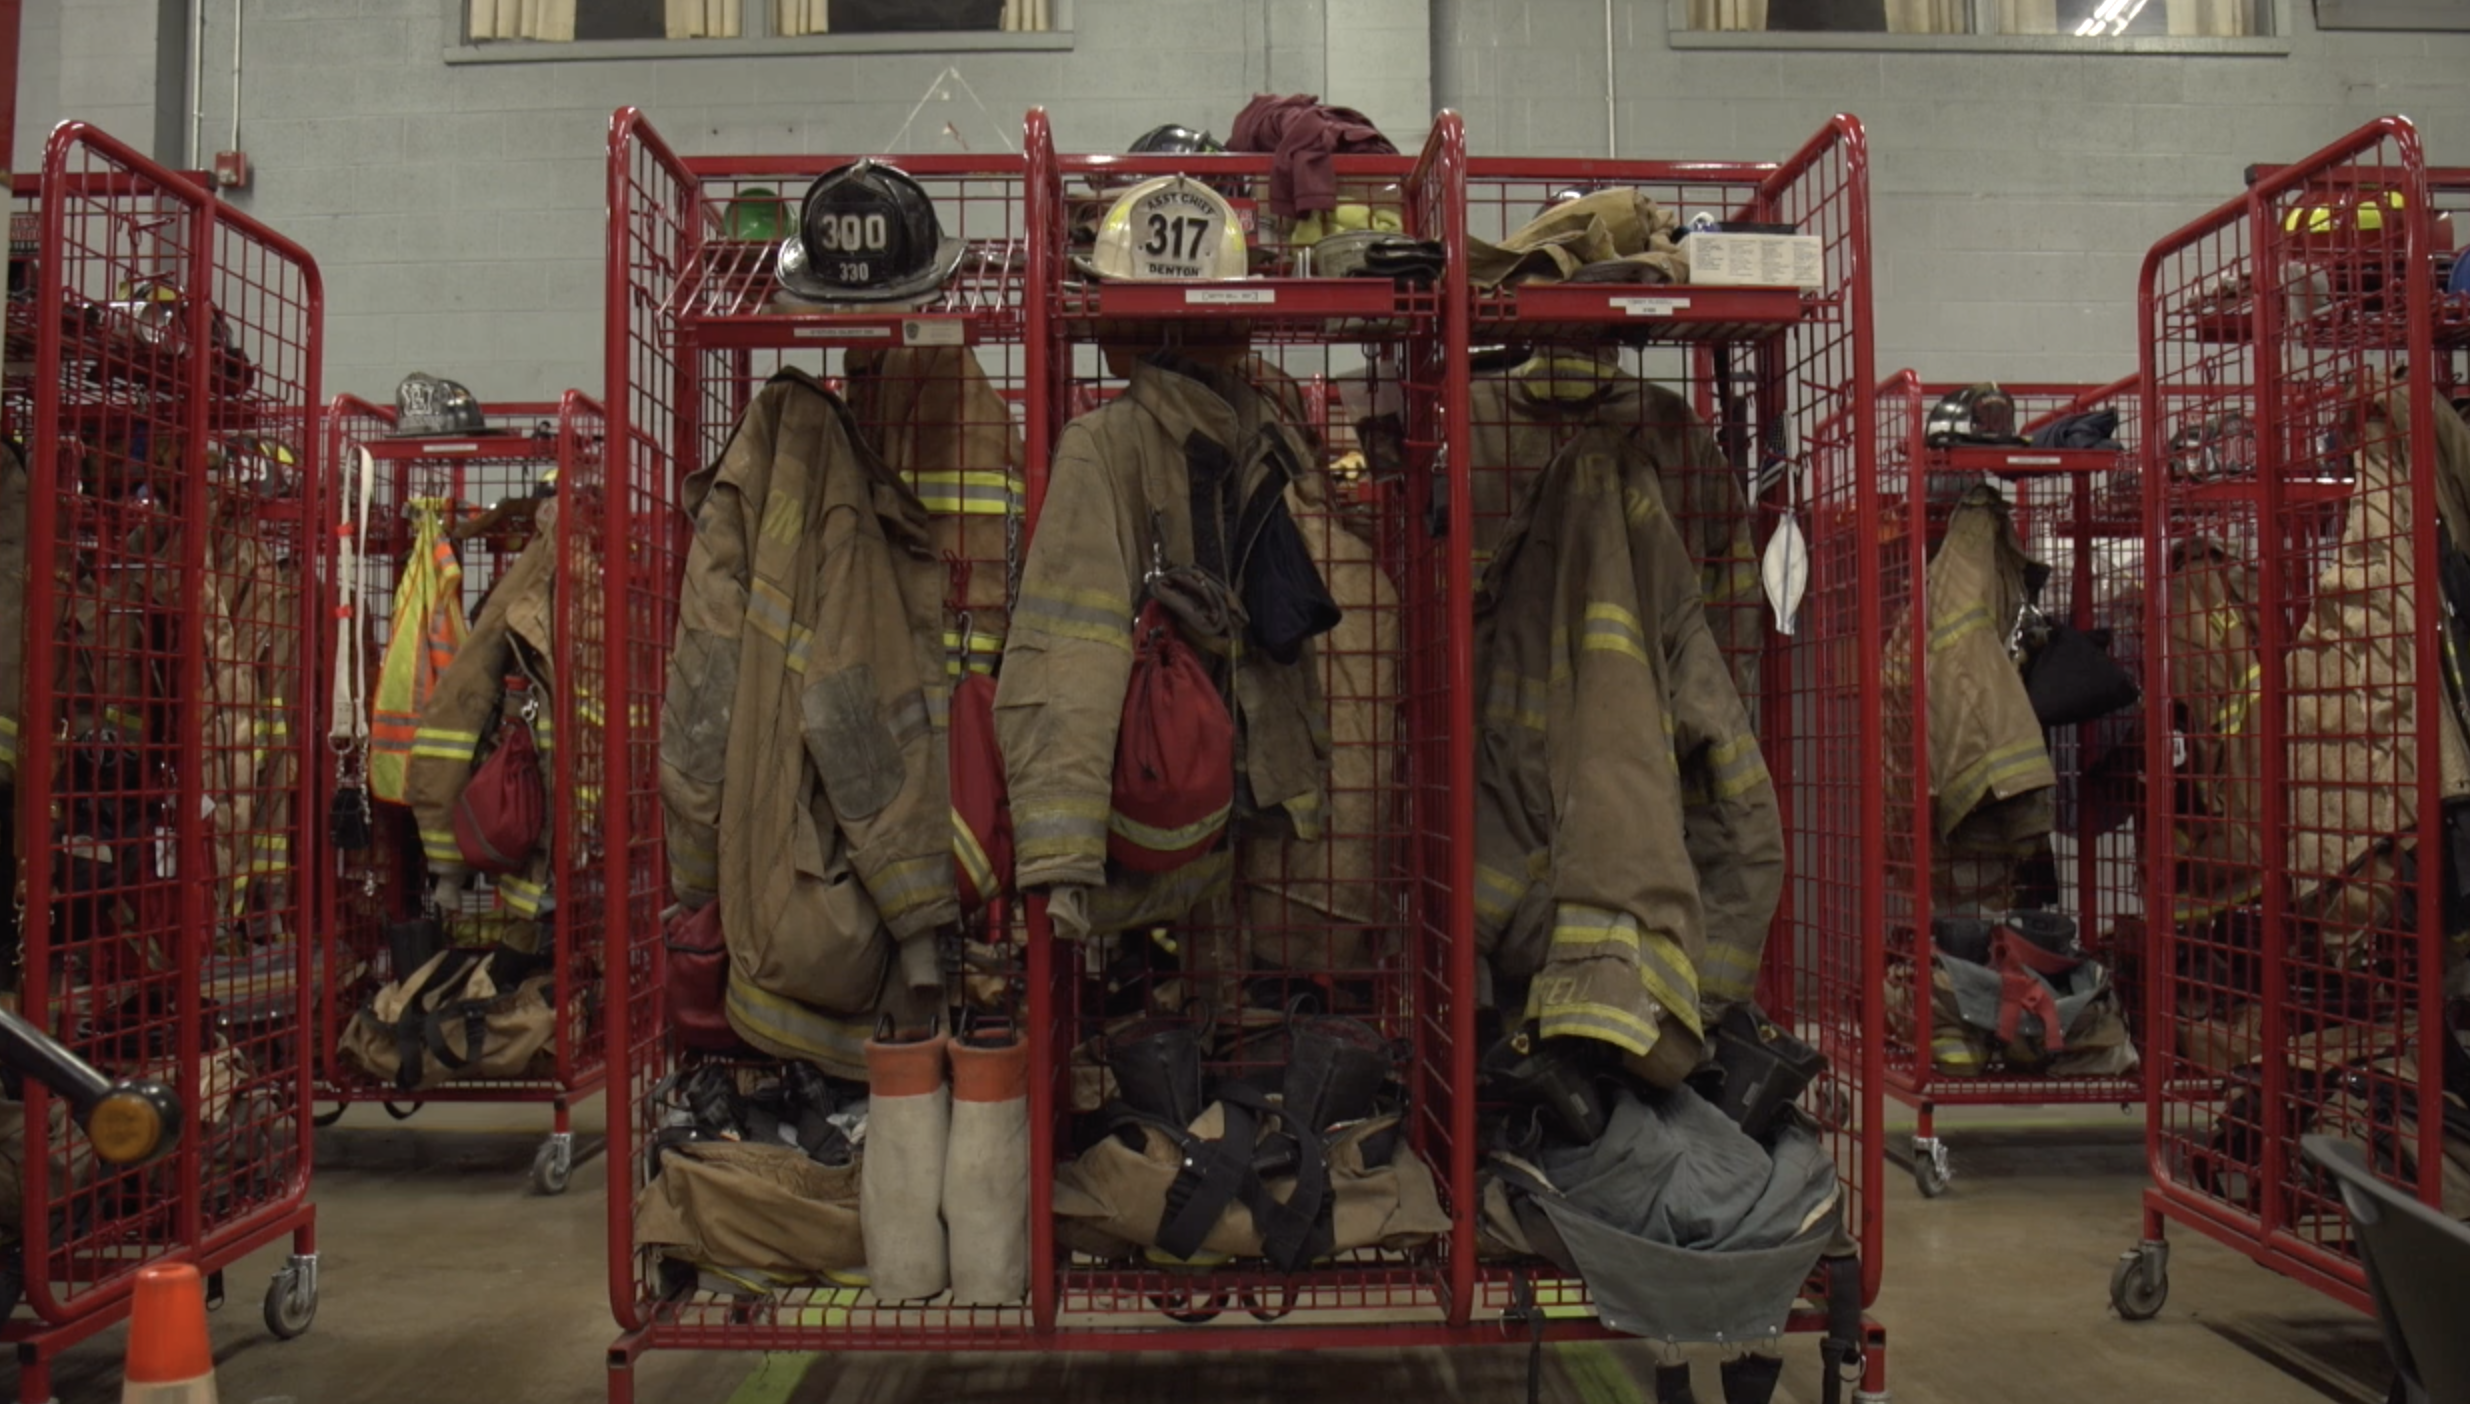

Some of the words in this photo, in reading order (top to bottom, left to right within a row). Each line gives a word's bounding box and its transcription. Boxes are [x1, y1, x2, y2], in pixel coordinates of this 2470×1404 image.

[1181, 194, 1216, 215] CHIEF
[822, 214, 886, 250] 300
[1145, 213, 1209, 260] 317
[840, 262, 869, 281] 330
[1149, 264, 1199, 277] DENTON
